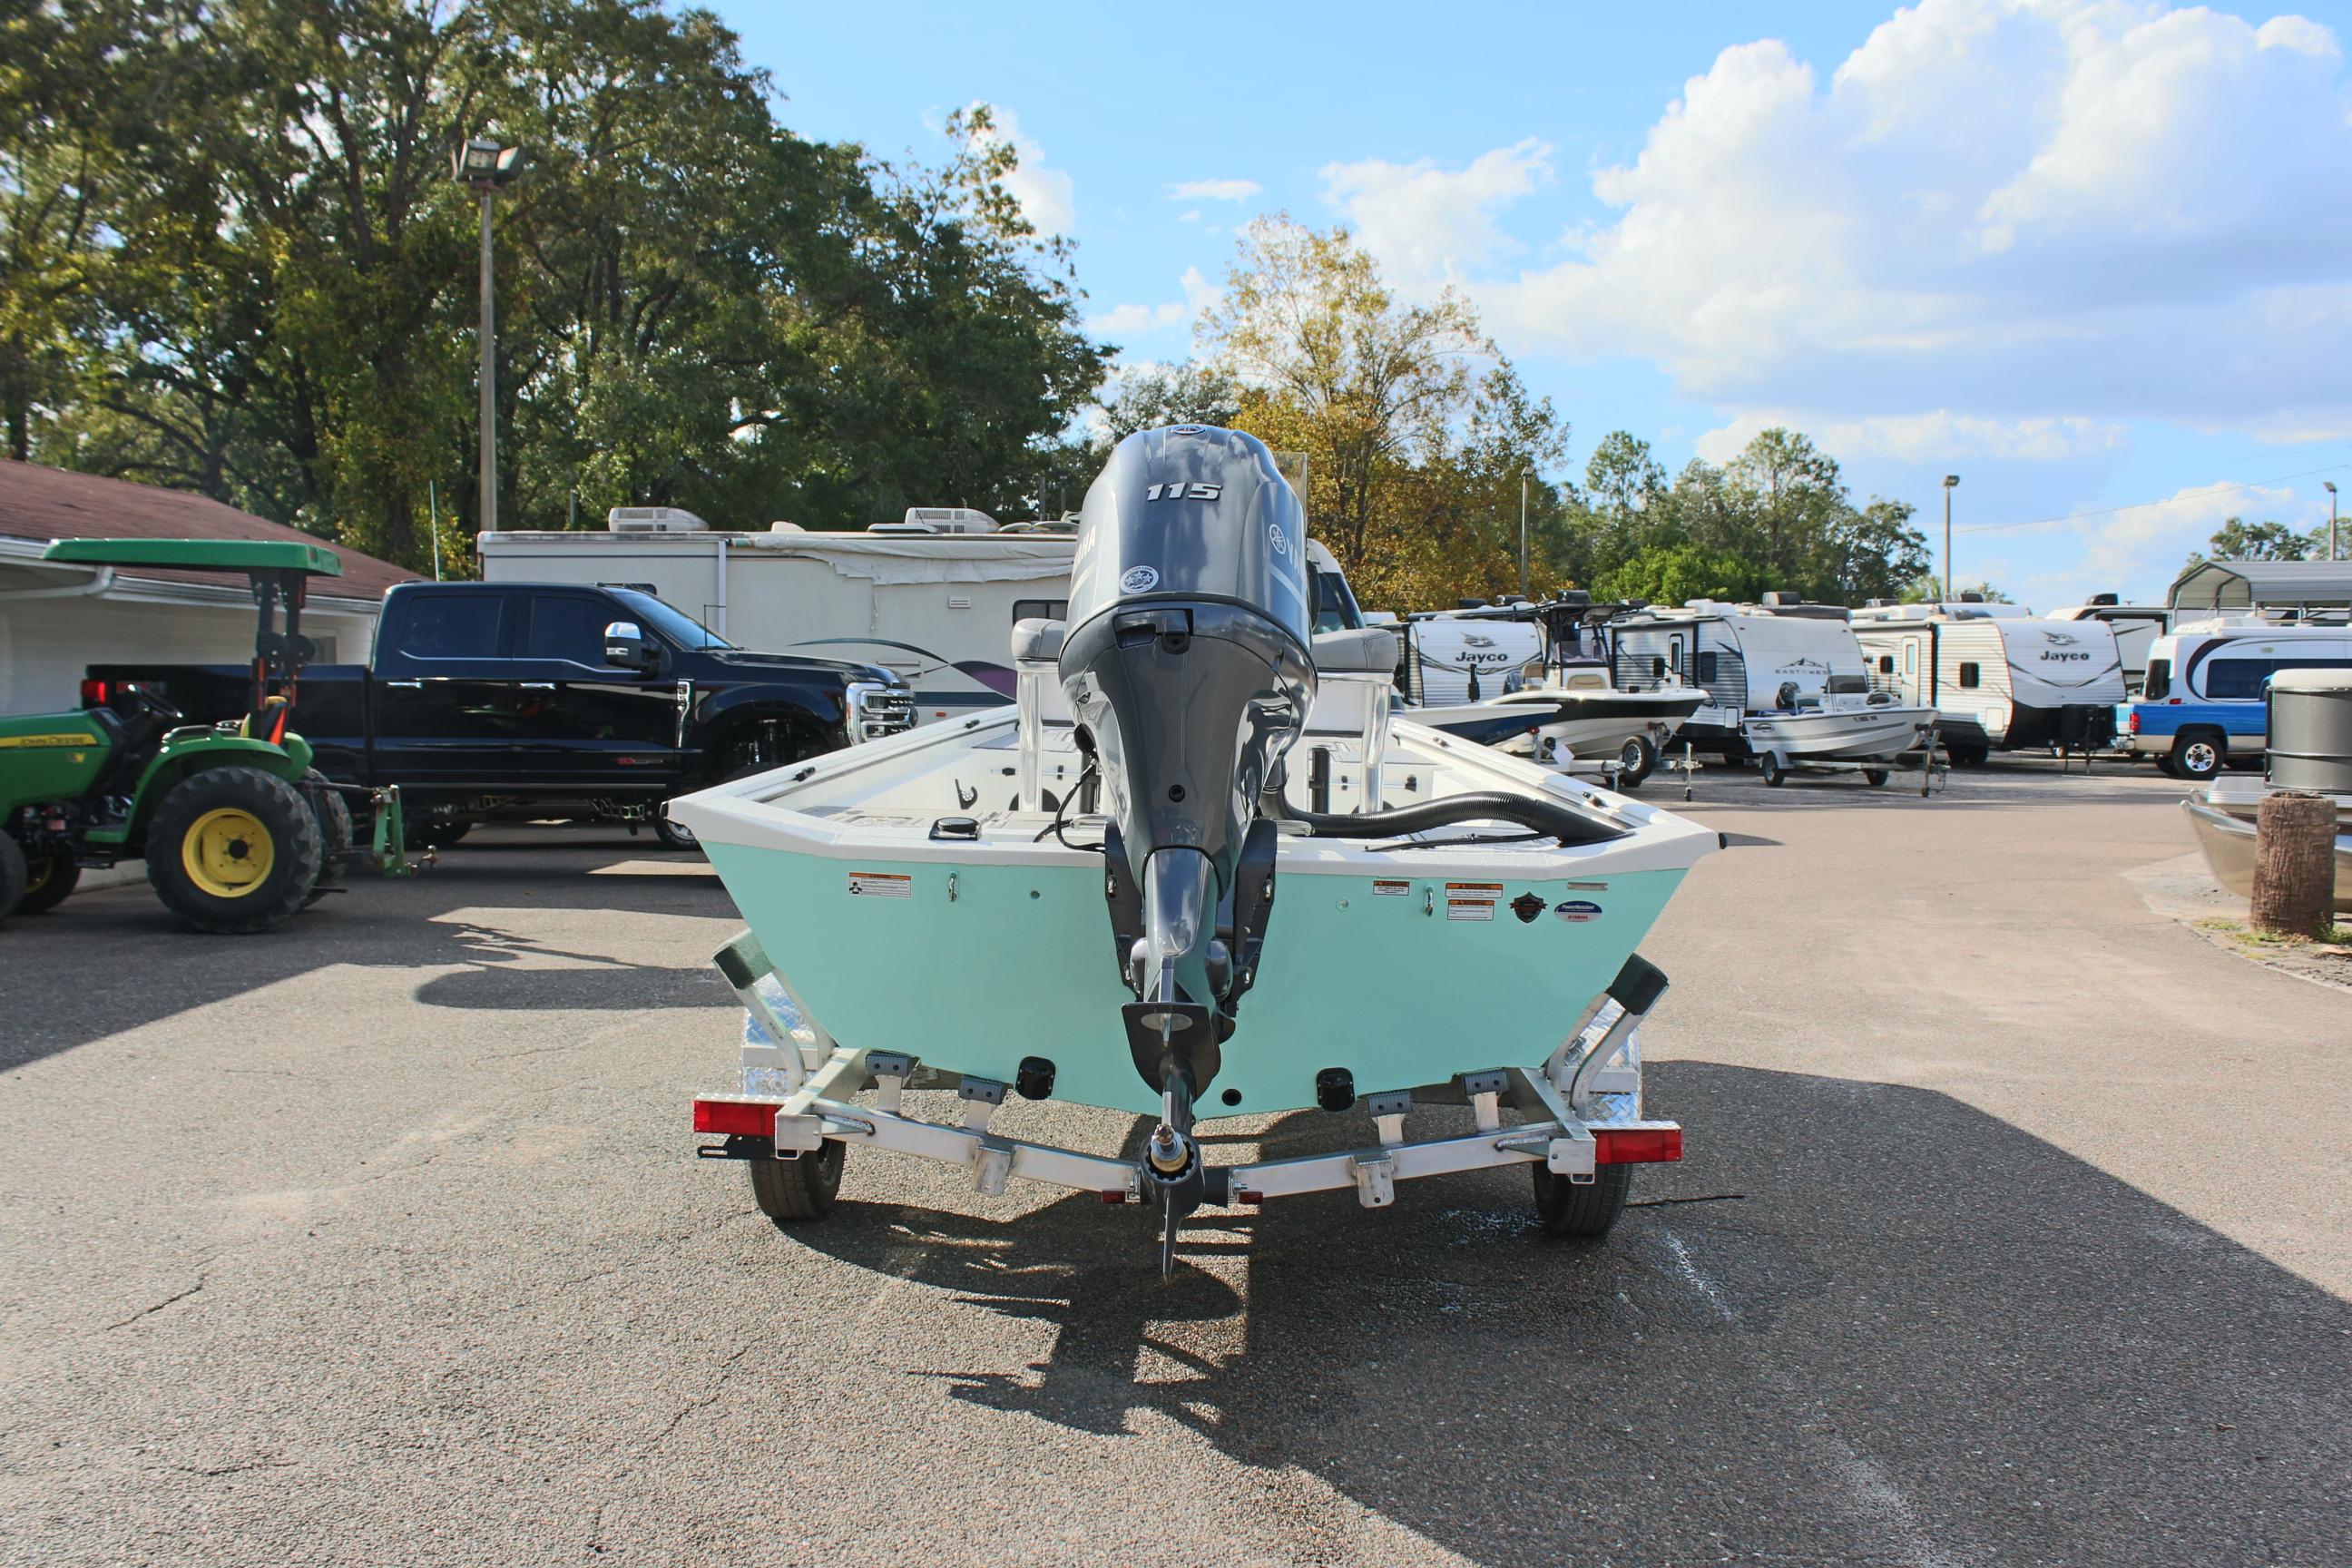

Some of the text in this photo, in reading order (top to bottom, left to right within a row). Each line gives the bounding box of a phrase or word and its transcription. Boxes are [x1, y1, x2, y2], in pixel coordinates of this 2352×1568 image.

[1146, 482, 1223, 502] 115
[1455, 652, 1508, 663] Jayco
[2040, 651, 2091, 662] Jayco
